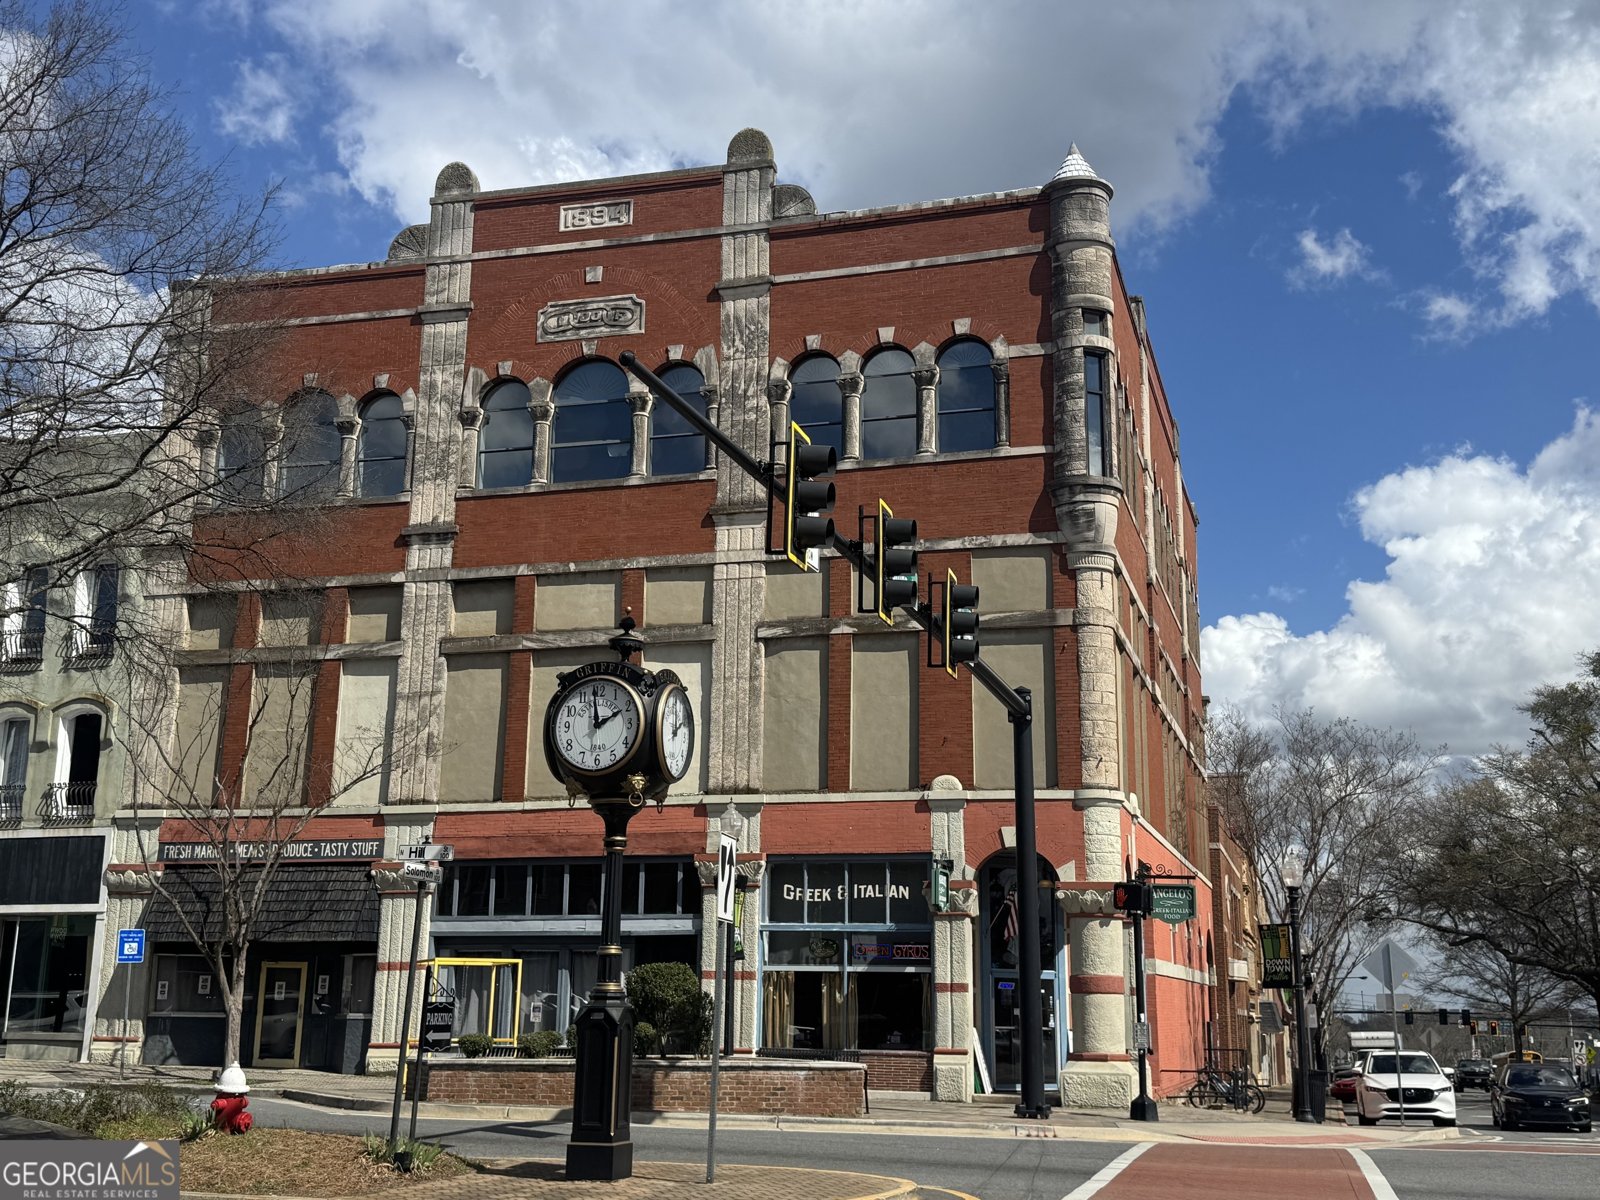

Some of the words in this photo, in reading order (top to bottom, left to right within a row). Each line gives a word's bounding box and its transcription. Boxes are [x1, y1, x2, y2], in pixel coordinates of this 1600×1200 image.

[564, 204, 629, 228] 1894
[576, 662, 631, 678] GRIFFIN
[595, 685, 606, 697] 12
[613, 689, 617, 700] 1
[579, 692, 587, 703] 11
[566, 705, 576, 717] 10
[577, 699, 620, 718] ESTALISHE
[625, 700, 632, 712] 2
[564, 721, 571, 733] 9
[627, 718, 633, 730] 3
[565, 739, 573, 751] 8
[590, 743, 606, 752] 1840
[622, 736, 630, 748] 4
[579, 751, 586, 764] 7
[594, 754, 601, 767] 6
[609, 749, 617, 762] 5
[163, 845, 192, 859] FRESH
[271, 843, 314, 857] PODUCE
[320, 842, 349, 856] TASTY
[351, 841, 380, 856] STUFF
[409, 846, 426, 859] Hill
[405, 865, 434, 879] Solomon
[1265, 958, 1291, 966] DOWN
[1265, 965, 1291, 973] TOWN
[426, 1012, 453, 1025] PARKING
